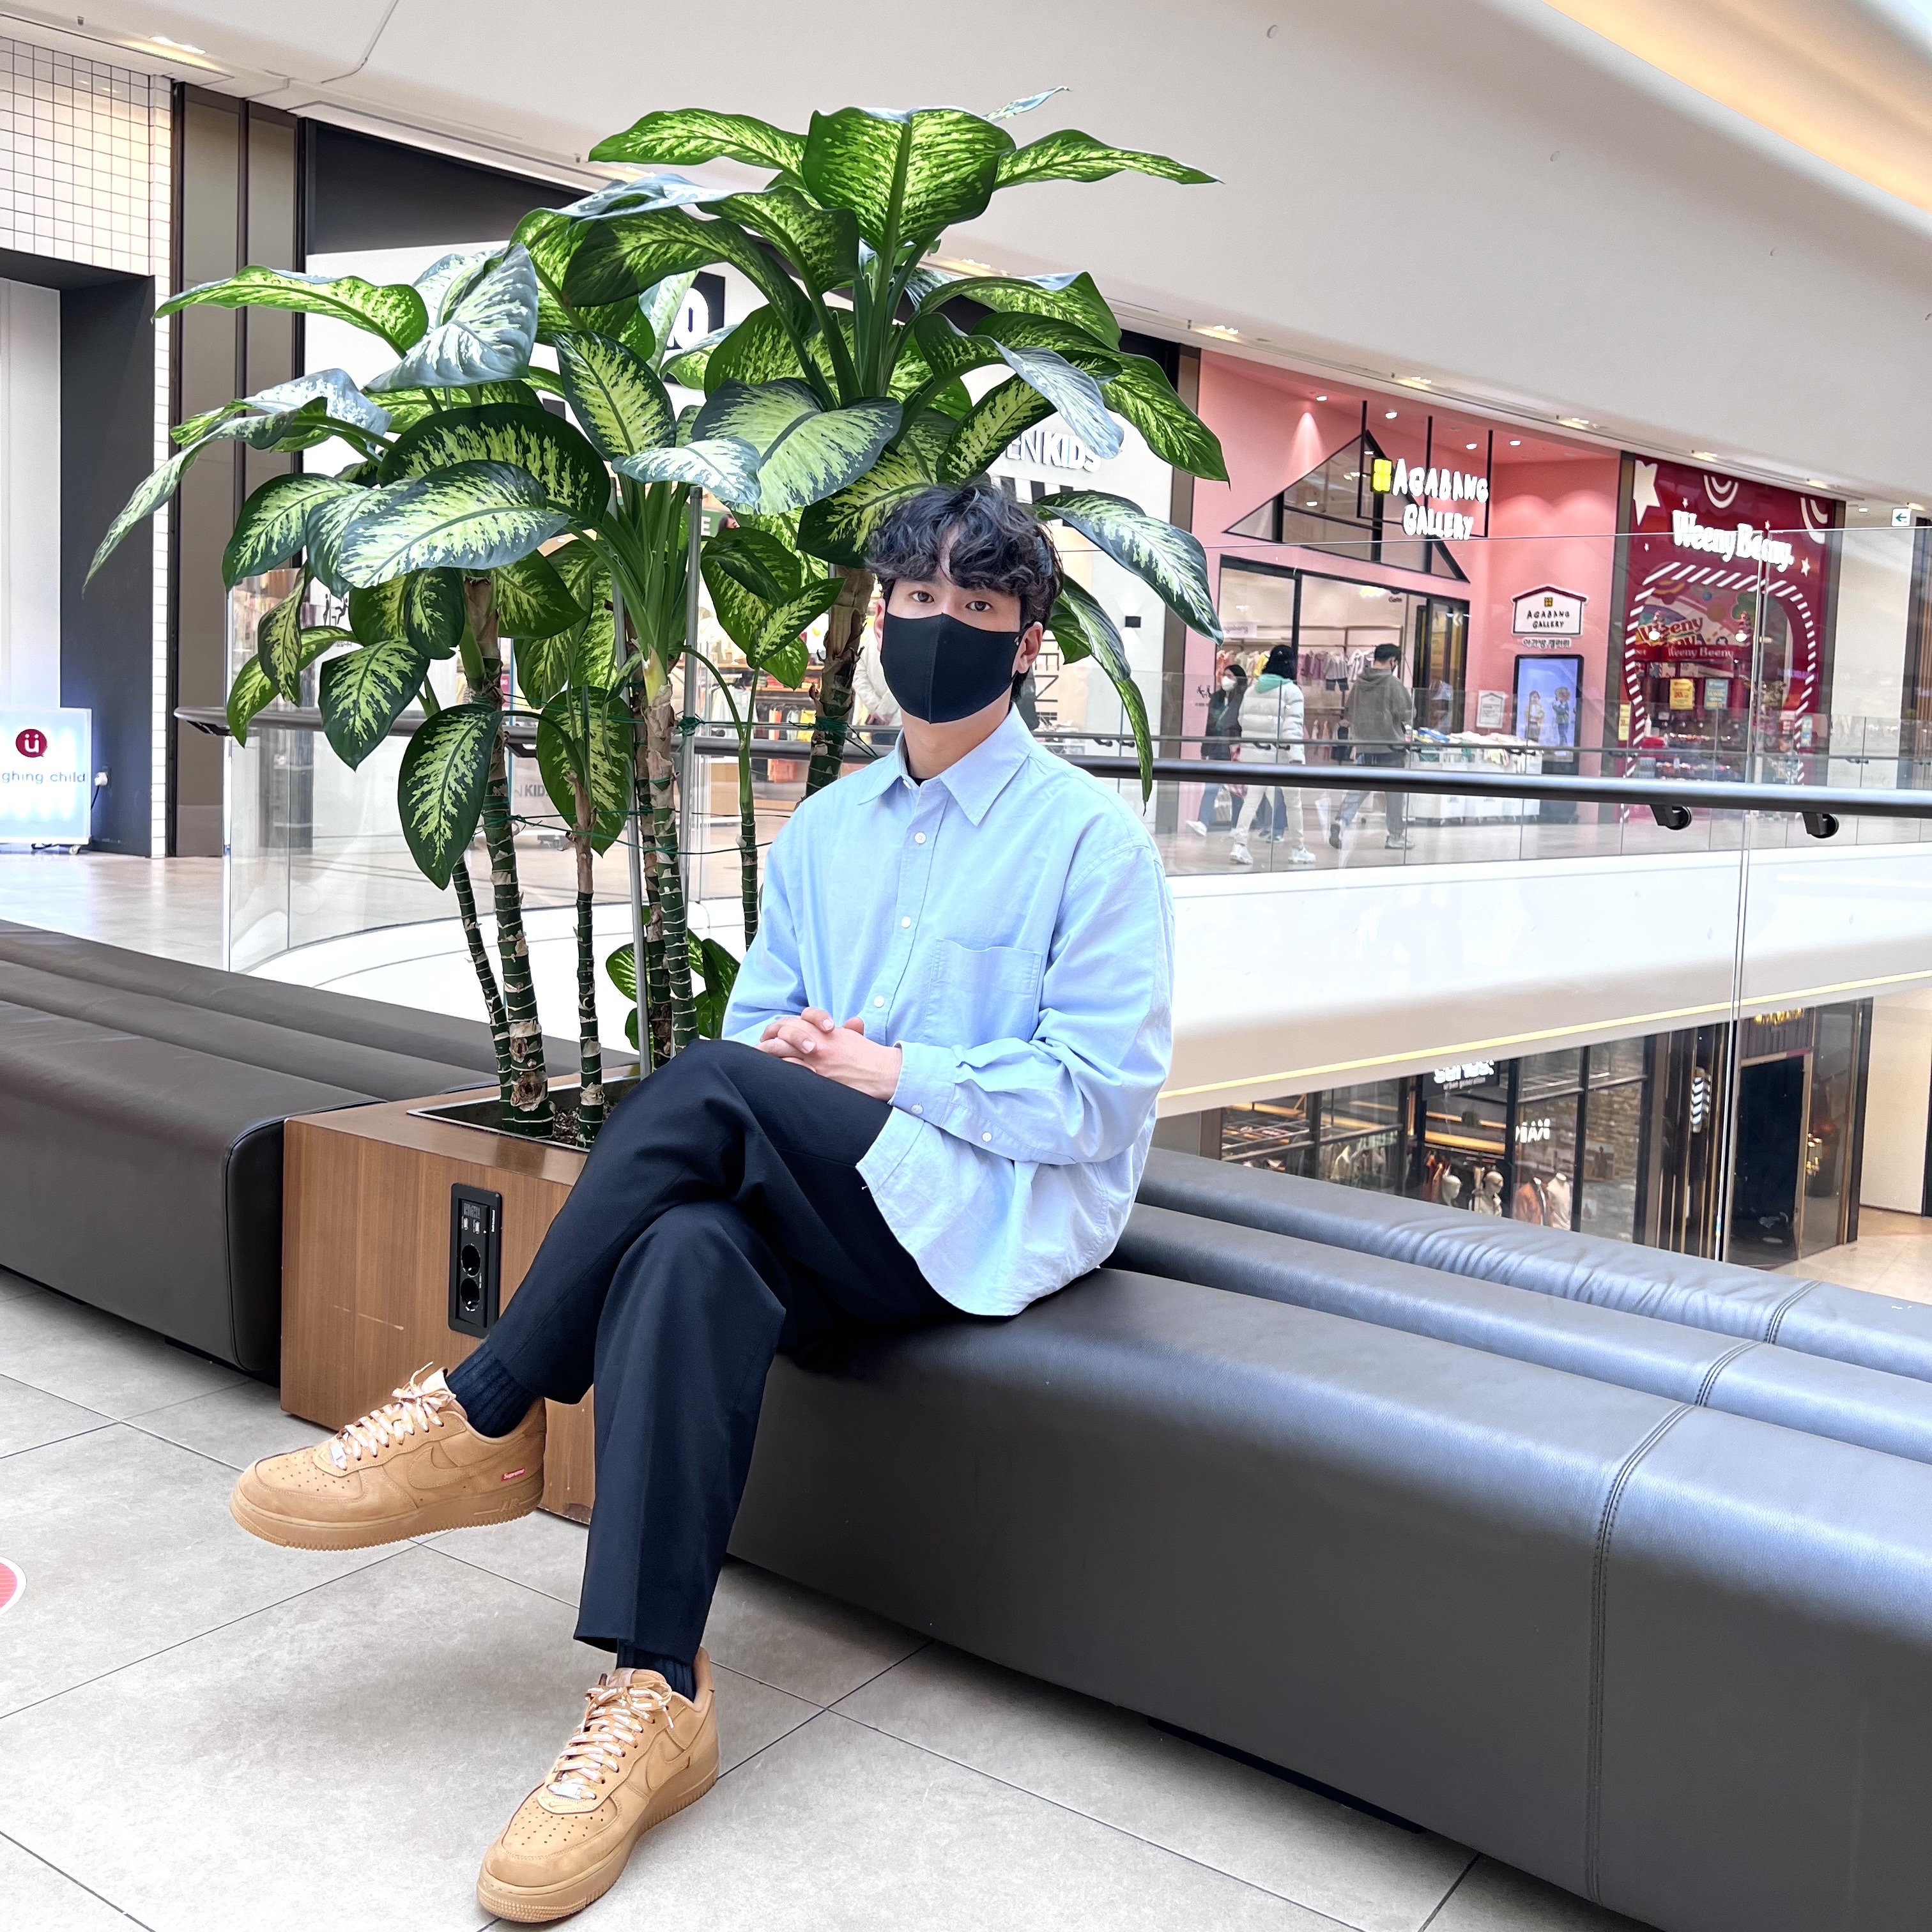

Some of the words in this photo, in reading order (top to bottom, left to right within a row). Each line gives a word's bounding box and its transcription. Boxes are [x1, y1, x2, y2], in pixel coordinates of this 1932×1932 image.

[1392, 458, 1489, 503] AGABANG
[1403, 503, 1474, 540] GALLERY
[1672, 509, 1737, 562] Weeny
[1526, 610, 1570, 619] AGABANG
[1532, 620, 1564, 629] GALLERY
[50, 771, 86, 783] child
